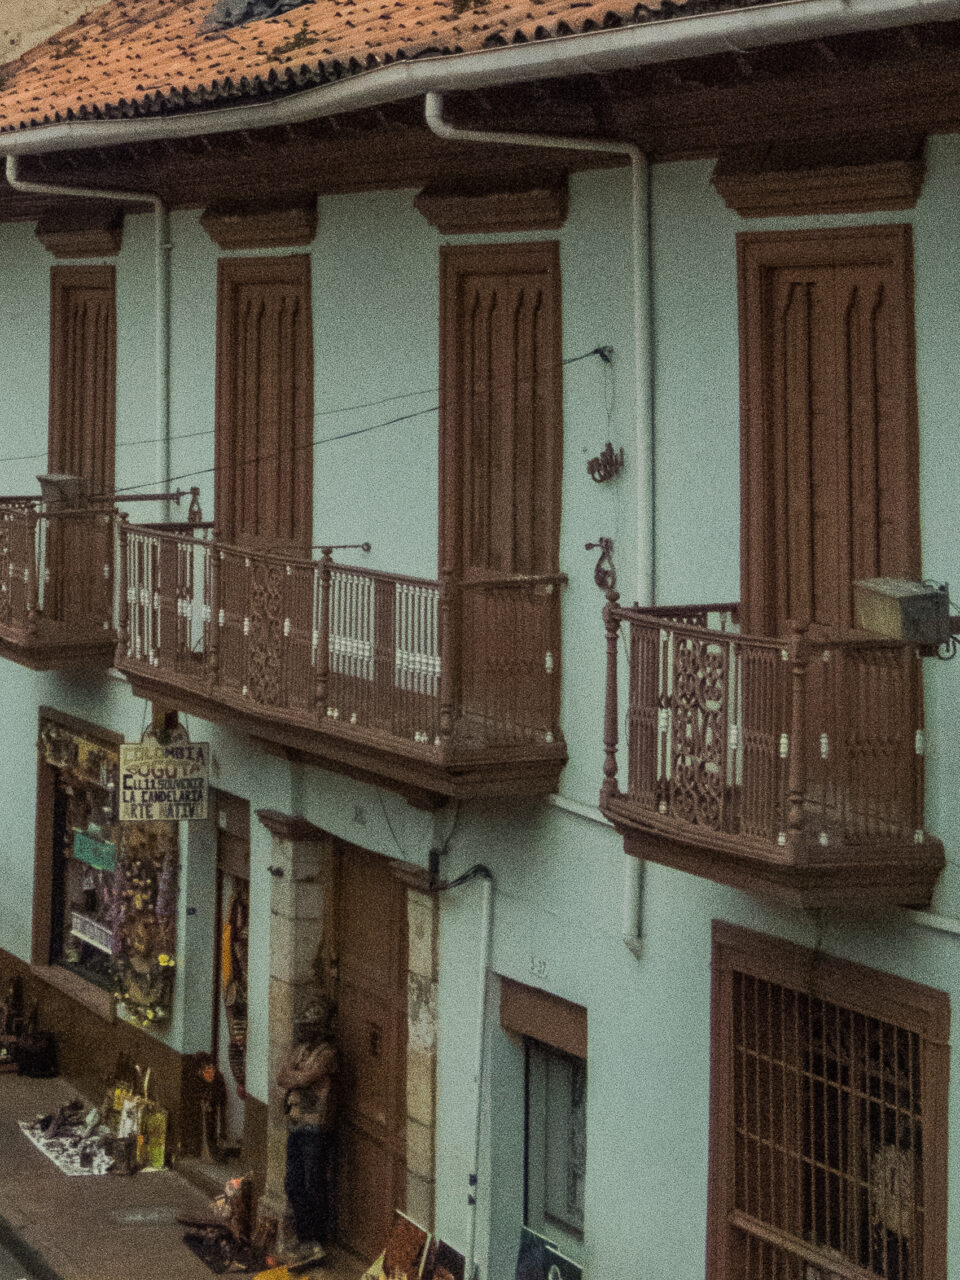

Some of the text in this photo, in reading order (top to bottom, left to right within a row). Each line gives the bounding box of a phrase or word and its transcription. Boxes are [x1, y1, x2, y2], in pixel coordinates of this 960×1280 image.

[123, 747, 205, 765] COLOMBIA
[122, 789, 204, 803] LA CANDELARIA
